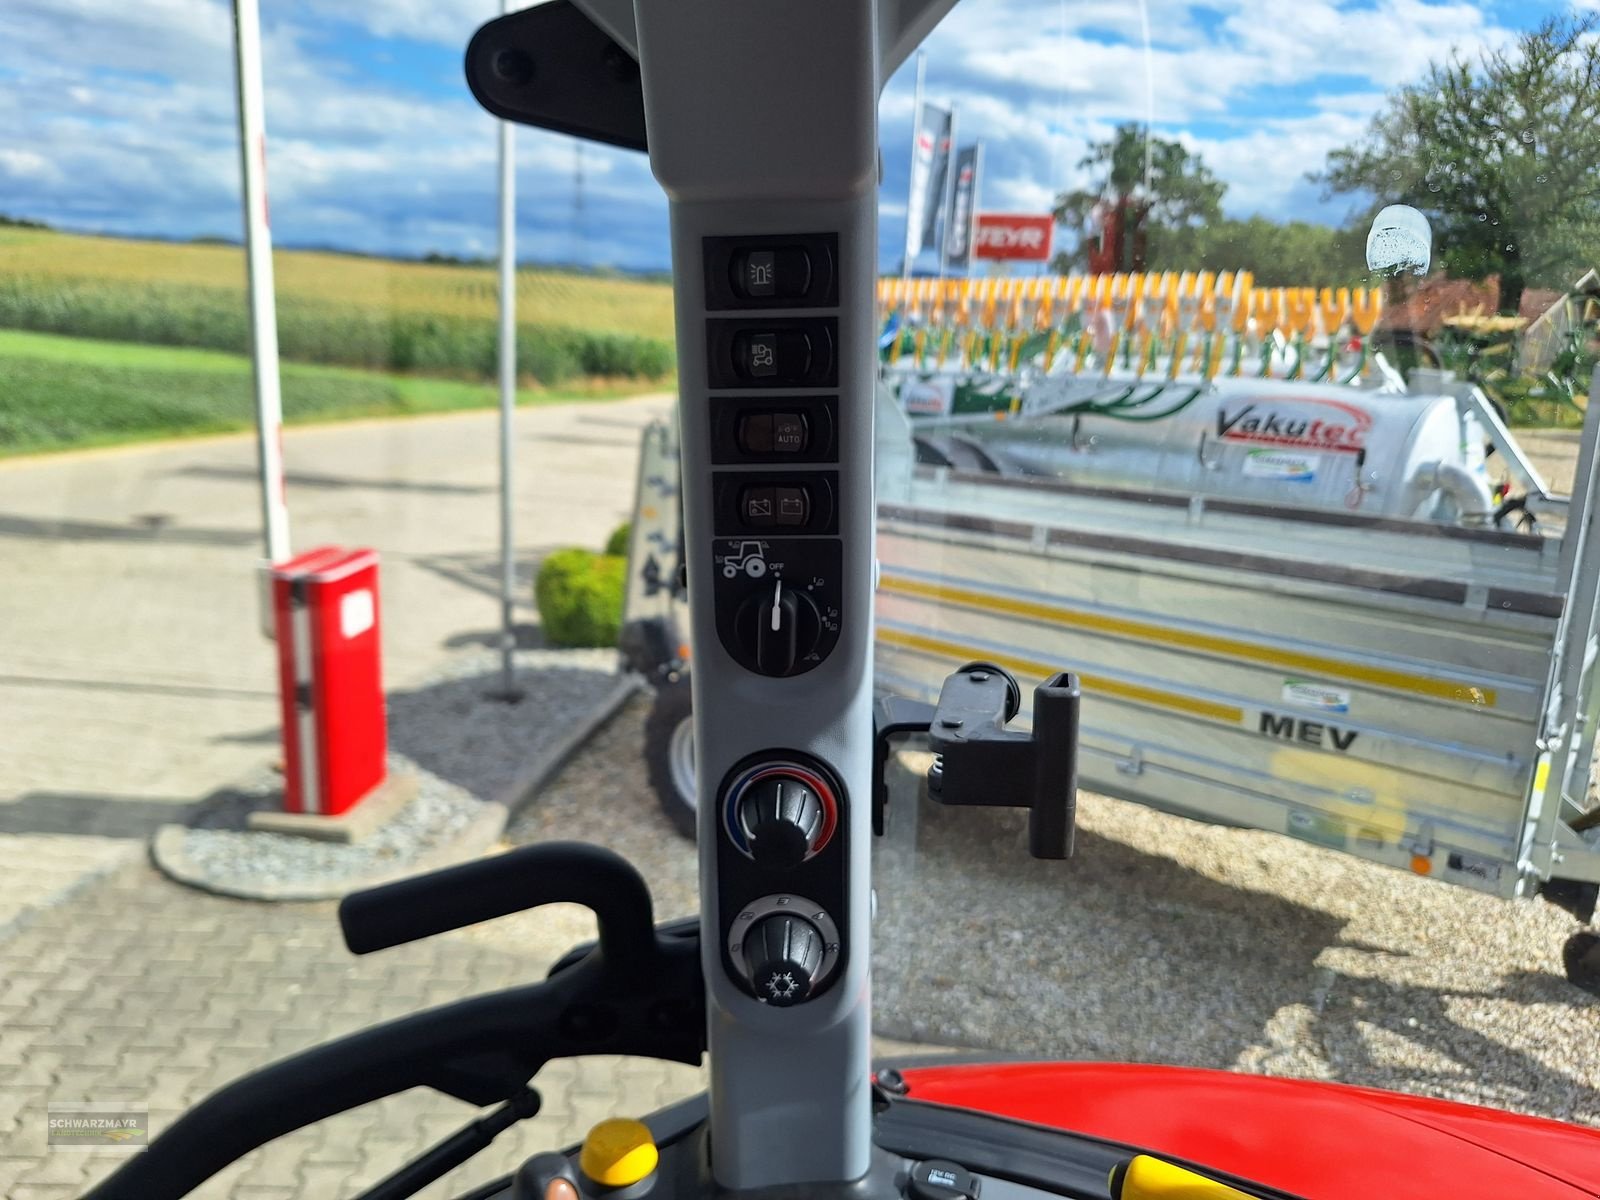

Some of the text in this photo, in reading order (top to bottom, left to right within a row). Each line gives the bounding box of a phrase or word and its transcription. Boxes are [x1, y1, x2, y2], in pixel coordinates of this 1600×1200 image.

[977, 225, 1043, 249] TEYR
[1217, 403, 1364, 444] Vakutec
[778, 435, 800, 443] AUTO
[769, 562, 784, 570] OFF
[1260, 711, 1358, 750] MEV
